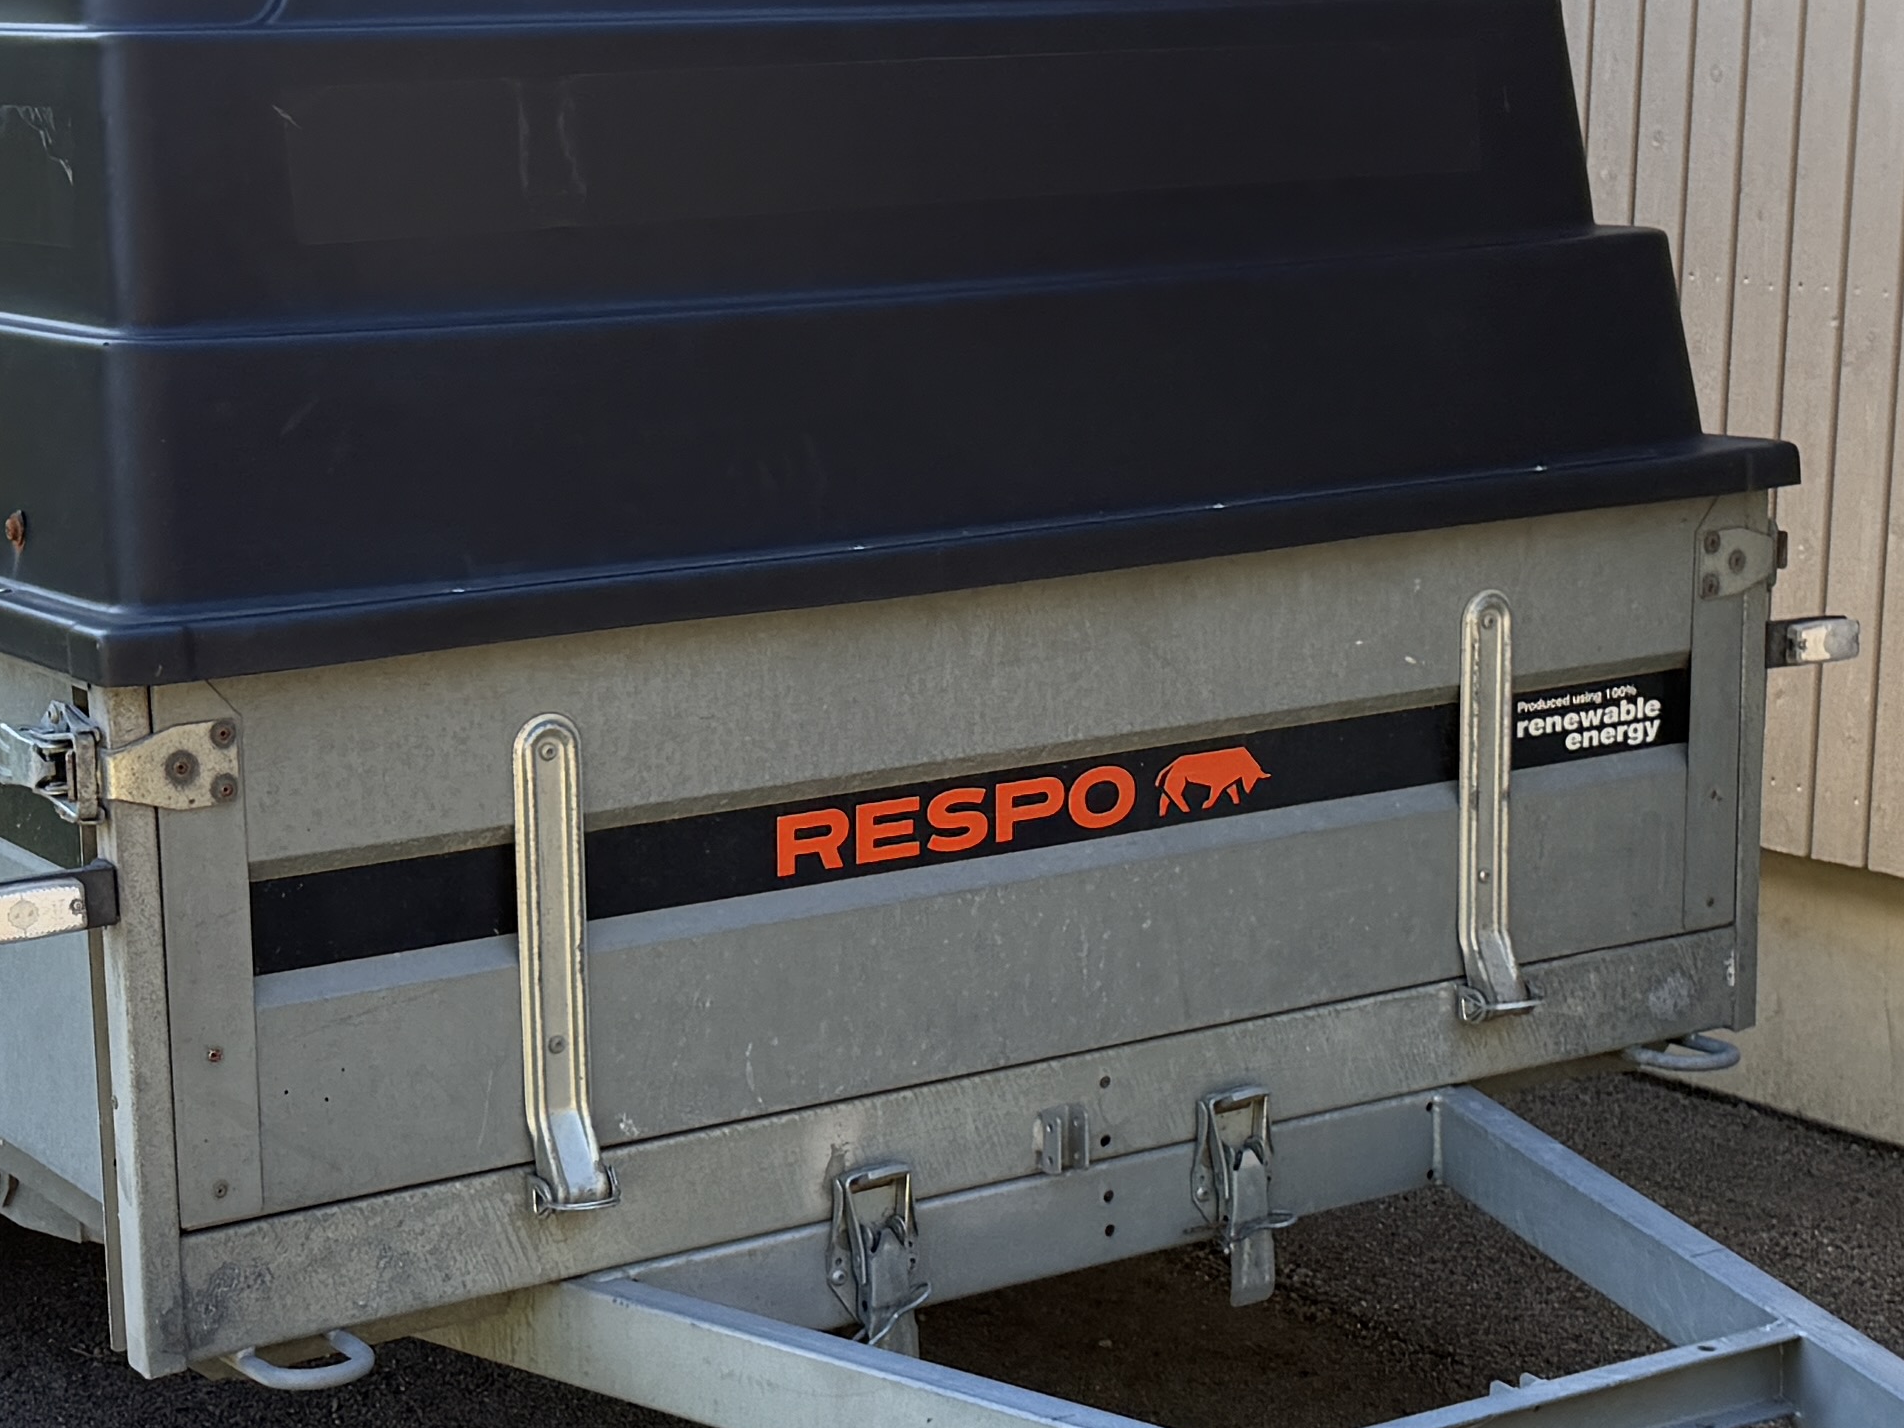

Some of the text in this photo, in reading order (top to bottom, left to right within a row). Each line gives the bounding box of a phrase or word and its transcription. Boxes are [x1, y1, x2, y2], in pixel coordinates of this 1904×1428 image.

[1517, 684, 1637, 714] Produced using 100%
[1516, 697, 1662, 738] renewable
[1565, 719, 1662, 751] energy
[777, 765, 1136, 877] RESPO
